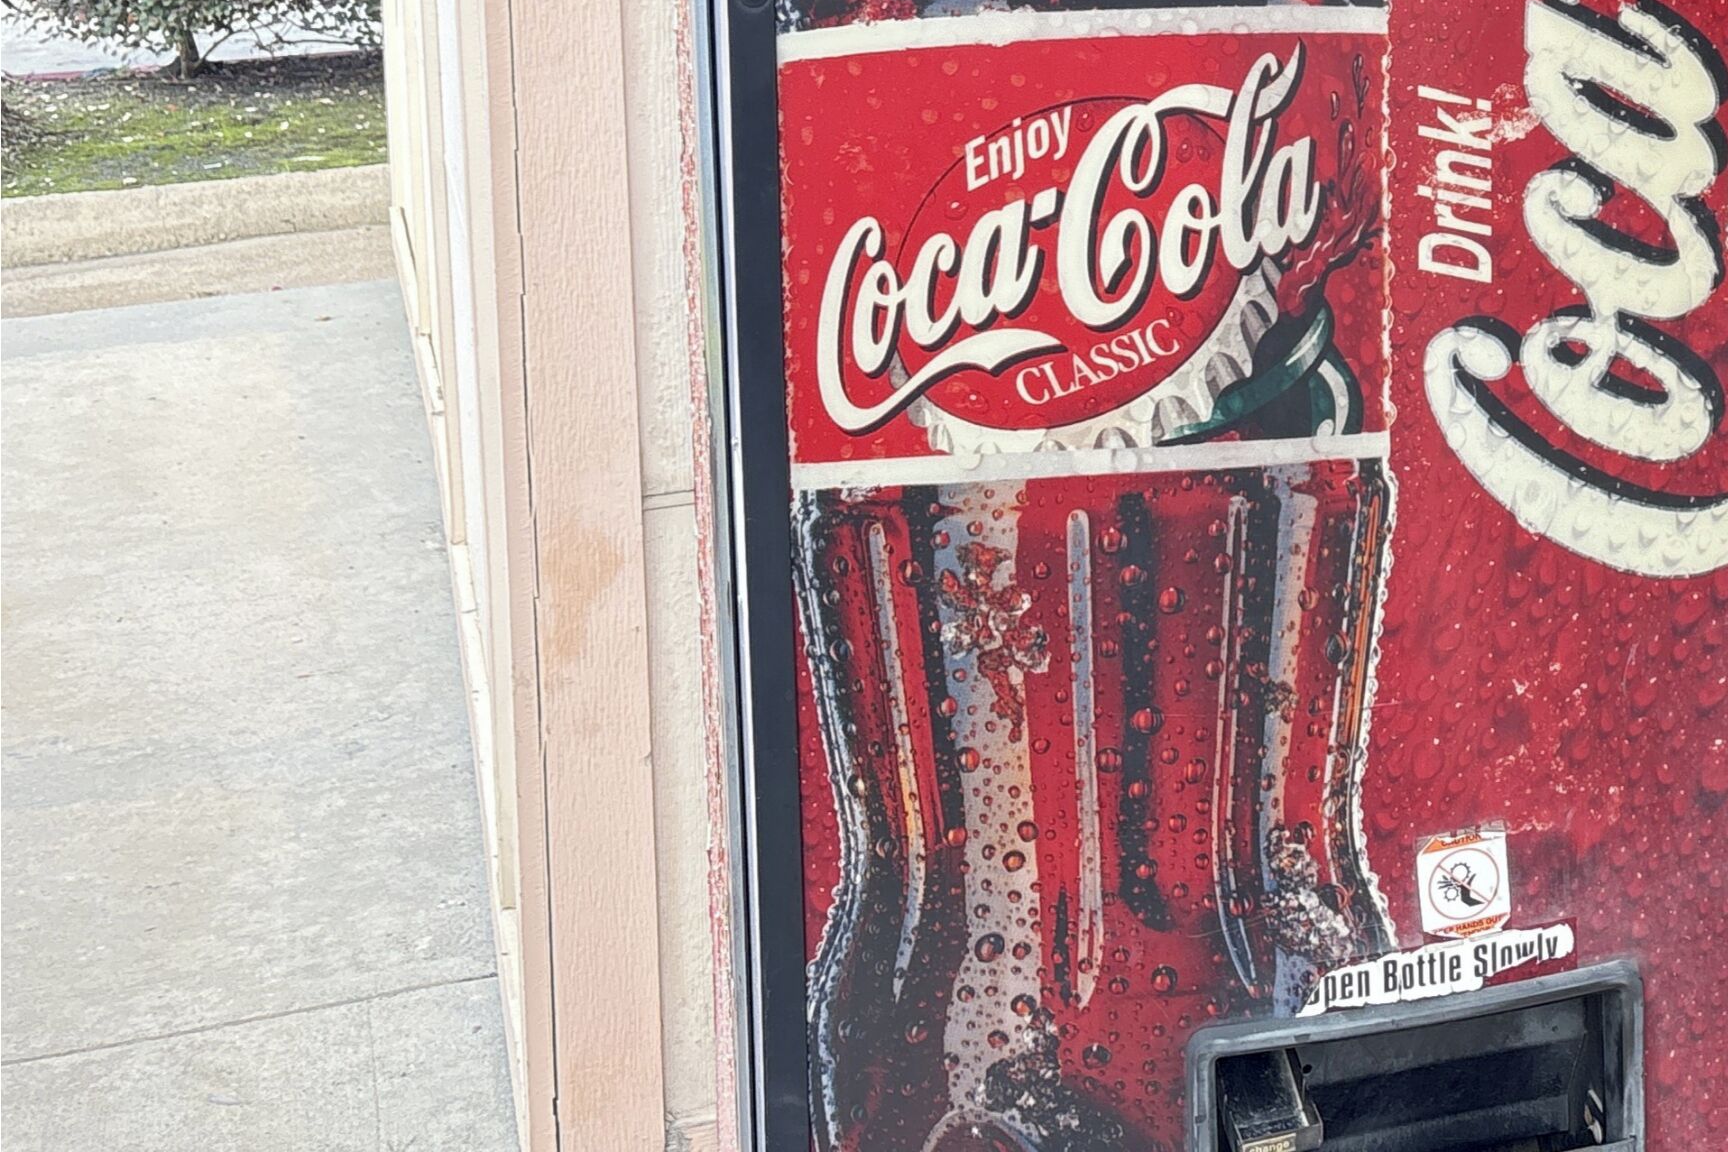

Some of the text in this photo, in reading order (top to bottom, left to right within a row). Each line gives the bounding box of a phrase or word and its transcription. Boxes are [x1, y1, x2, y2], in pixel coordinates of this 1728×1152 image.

[963, 103, 1073, 193] Enjoy
[1417, 82, 1495, 287] Drink!
[817, 38, 1322, 432] Coca-Cola
[1016, 319, 1181, 406] CLASSIC
[1455, 919, 1484, 932] HANDS
[1383, 950, 1461, 993] Bottle
